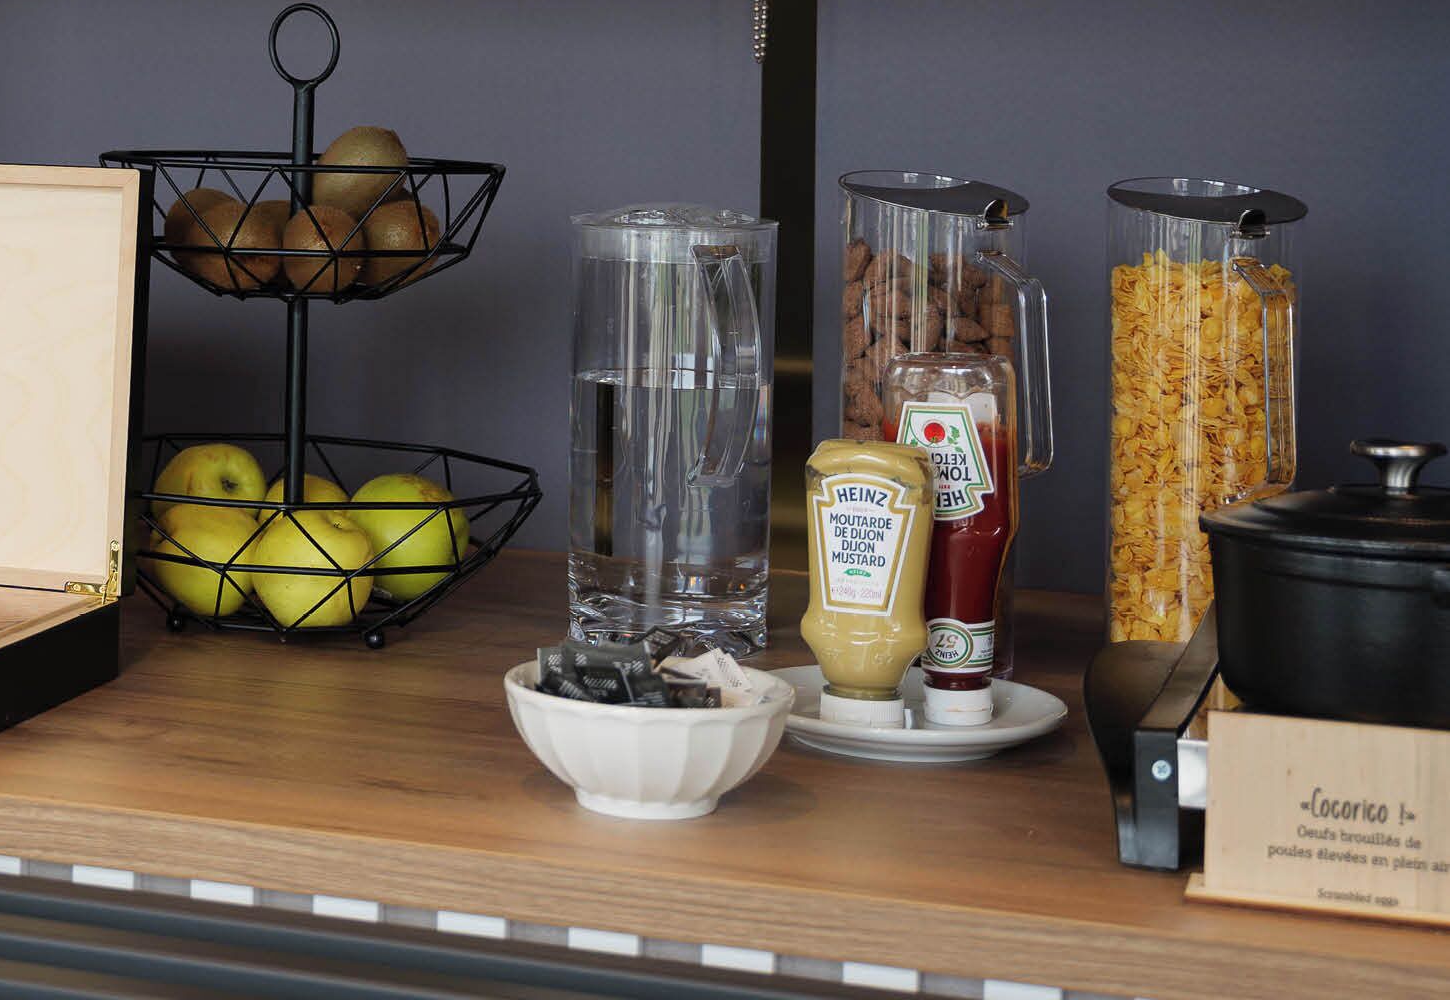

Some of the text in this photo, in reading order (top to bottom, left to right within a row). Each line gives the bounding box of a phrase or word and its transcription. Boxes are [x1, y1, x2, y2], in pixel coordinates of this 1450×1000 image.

[931, 453, 967, 466] KETC
[936, 466, 972, 482] TOM
[836, 487, 888, 507] HEINZ
[934, 489, 966, 508] HEI
[829, 513, 893, 530] MOUTARDE
[834, 525, 884, 542] DE DIJON
[841, 540, 875, 554] DIJON
[831, 551, 886, 568] MUSTARD
[935, 634, 959, 649] 57
[934, 648, 959, 660] HEINZ
[1297, 823, 1422, 850] Oeufs brouillés de
[1267, 844, 1313, 859] poules
[1317, 847, 1367, 864] élevées
[1371, 855, 1389, 868] en
[1392, 855, 1428, 872] plein
[1317, 887, 1399, 907] Scrambled eggs
